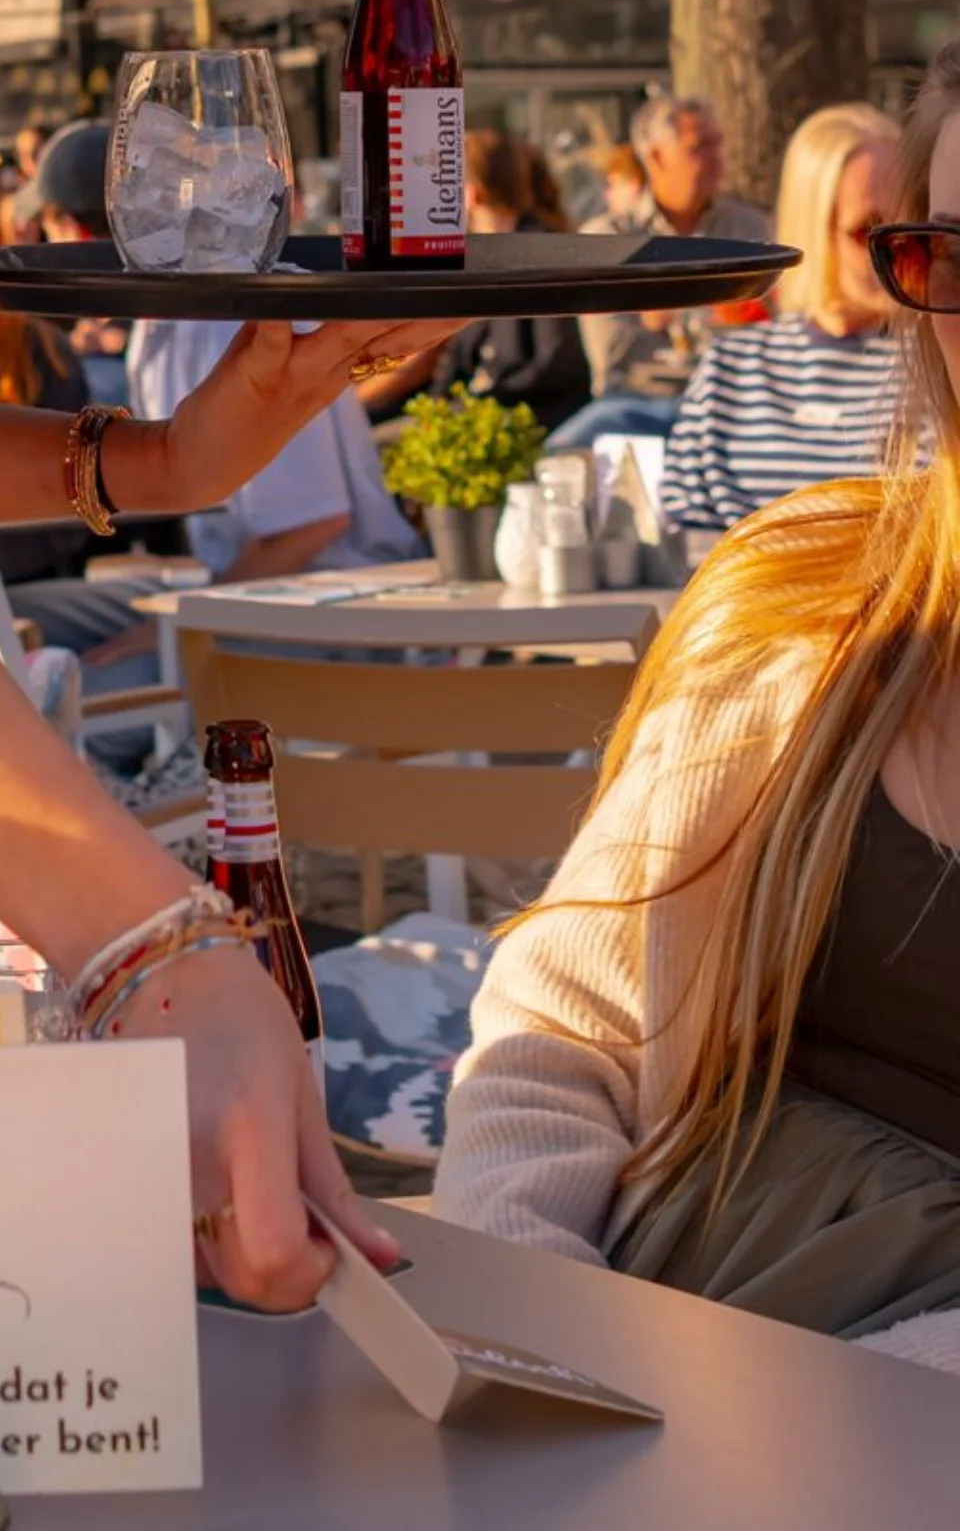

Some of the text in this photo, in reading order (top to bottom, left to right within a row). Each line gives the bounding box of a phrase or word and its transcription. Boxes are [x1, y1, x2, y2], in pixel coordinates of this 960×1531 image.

[427, 97, 460, 229] Liefmans
[0, 1365, 67, 1403] dat
[86, 1369, 119, 1410] je
[1, 1416, 159, 1455] er bent!
